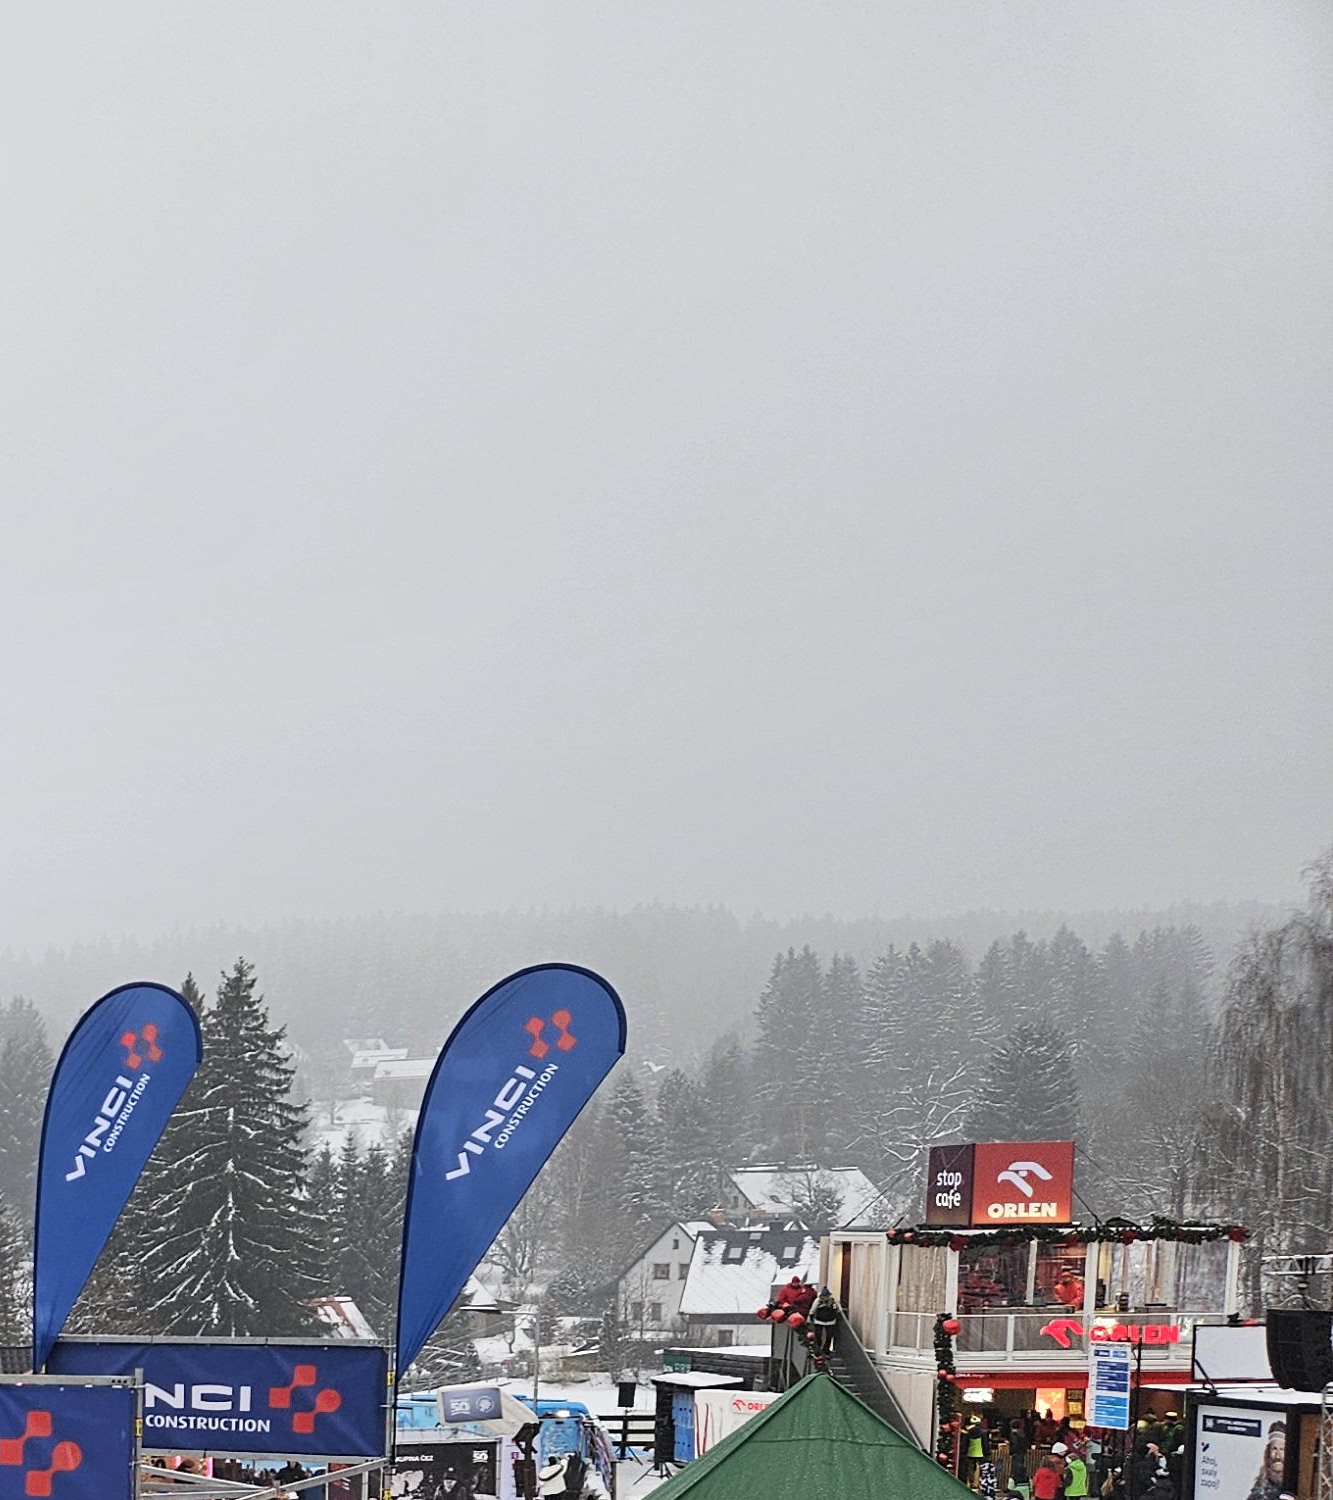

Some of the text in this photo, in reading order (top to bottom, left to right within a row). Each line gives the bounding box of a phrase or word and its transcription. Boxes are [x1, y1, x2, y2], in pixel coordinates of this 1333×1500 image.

[103, 1073, 151, 1153] CONSTRUCTION
[493, 1063, 559, 1149] CONSTRUCTION
[65, 1075, 133, 1182] VINCI
[445, 1065, 536, 1181] VINCI
[937, 1170, 962, 1190] stop
[935, 1190, 962, 1209] cafe
[987, 1202, 1058, 1219] ORLEN
[1090, 1324, 1180, 1344] ORLEN
[144, 1382, 251, 1412] NCI
[144, 1413, 271, 1433] CONSTRUCTION
